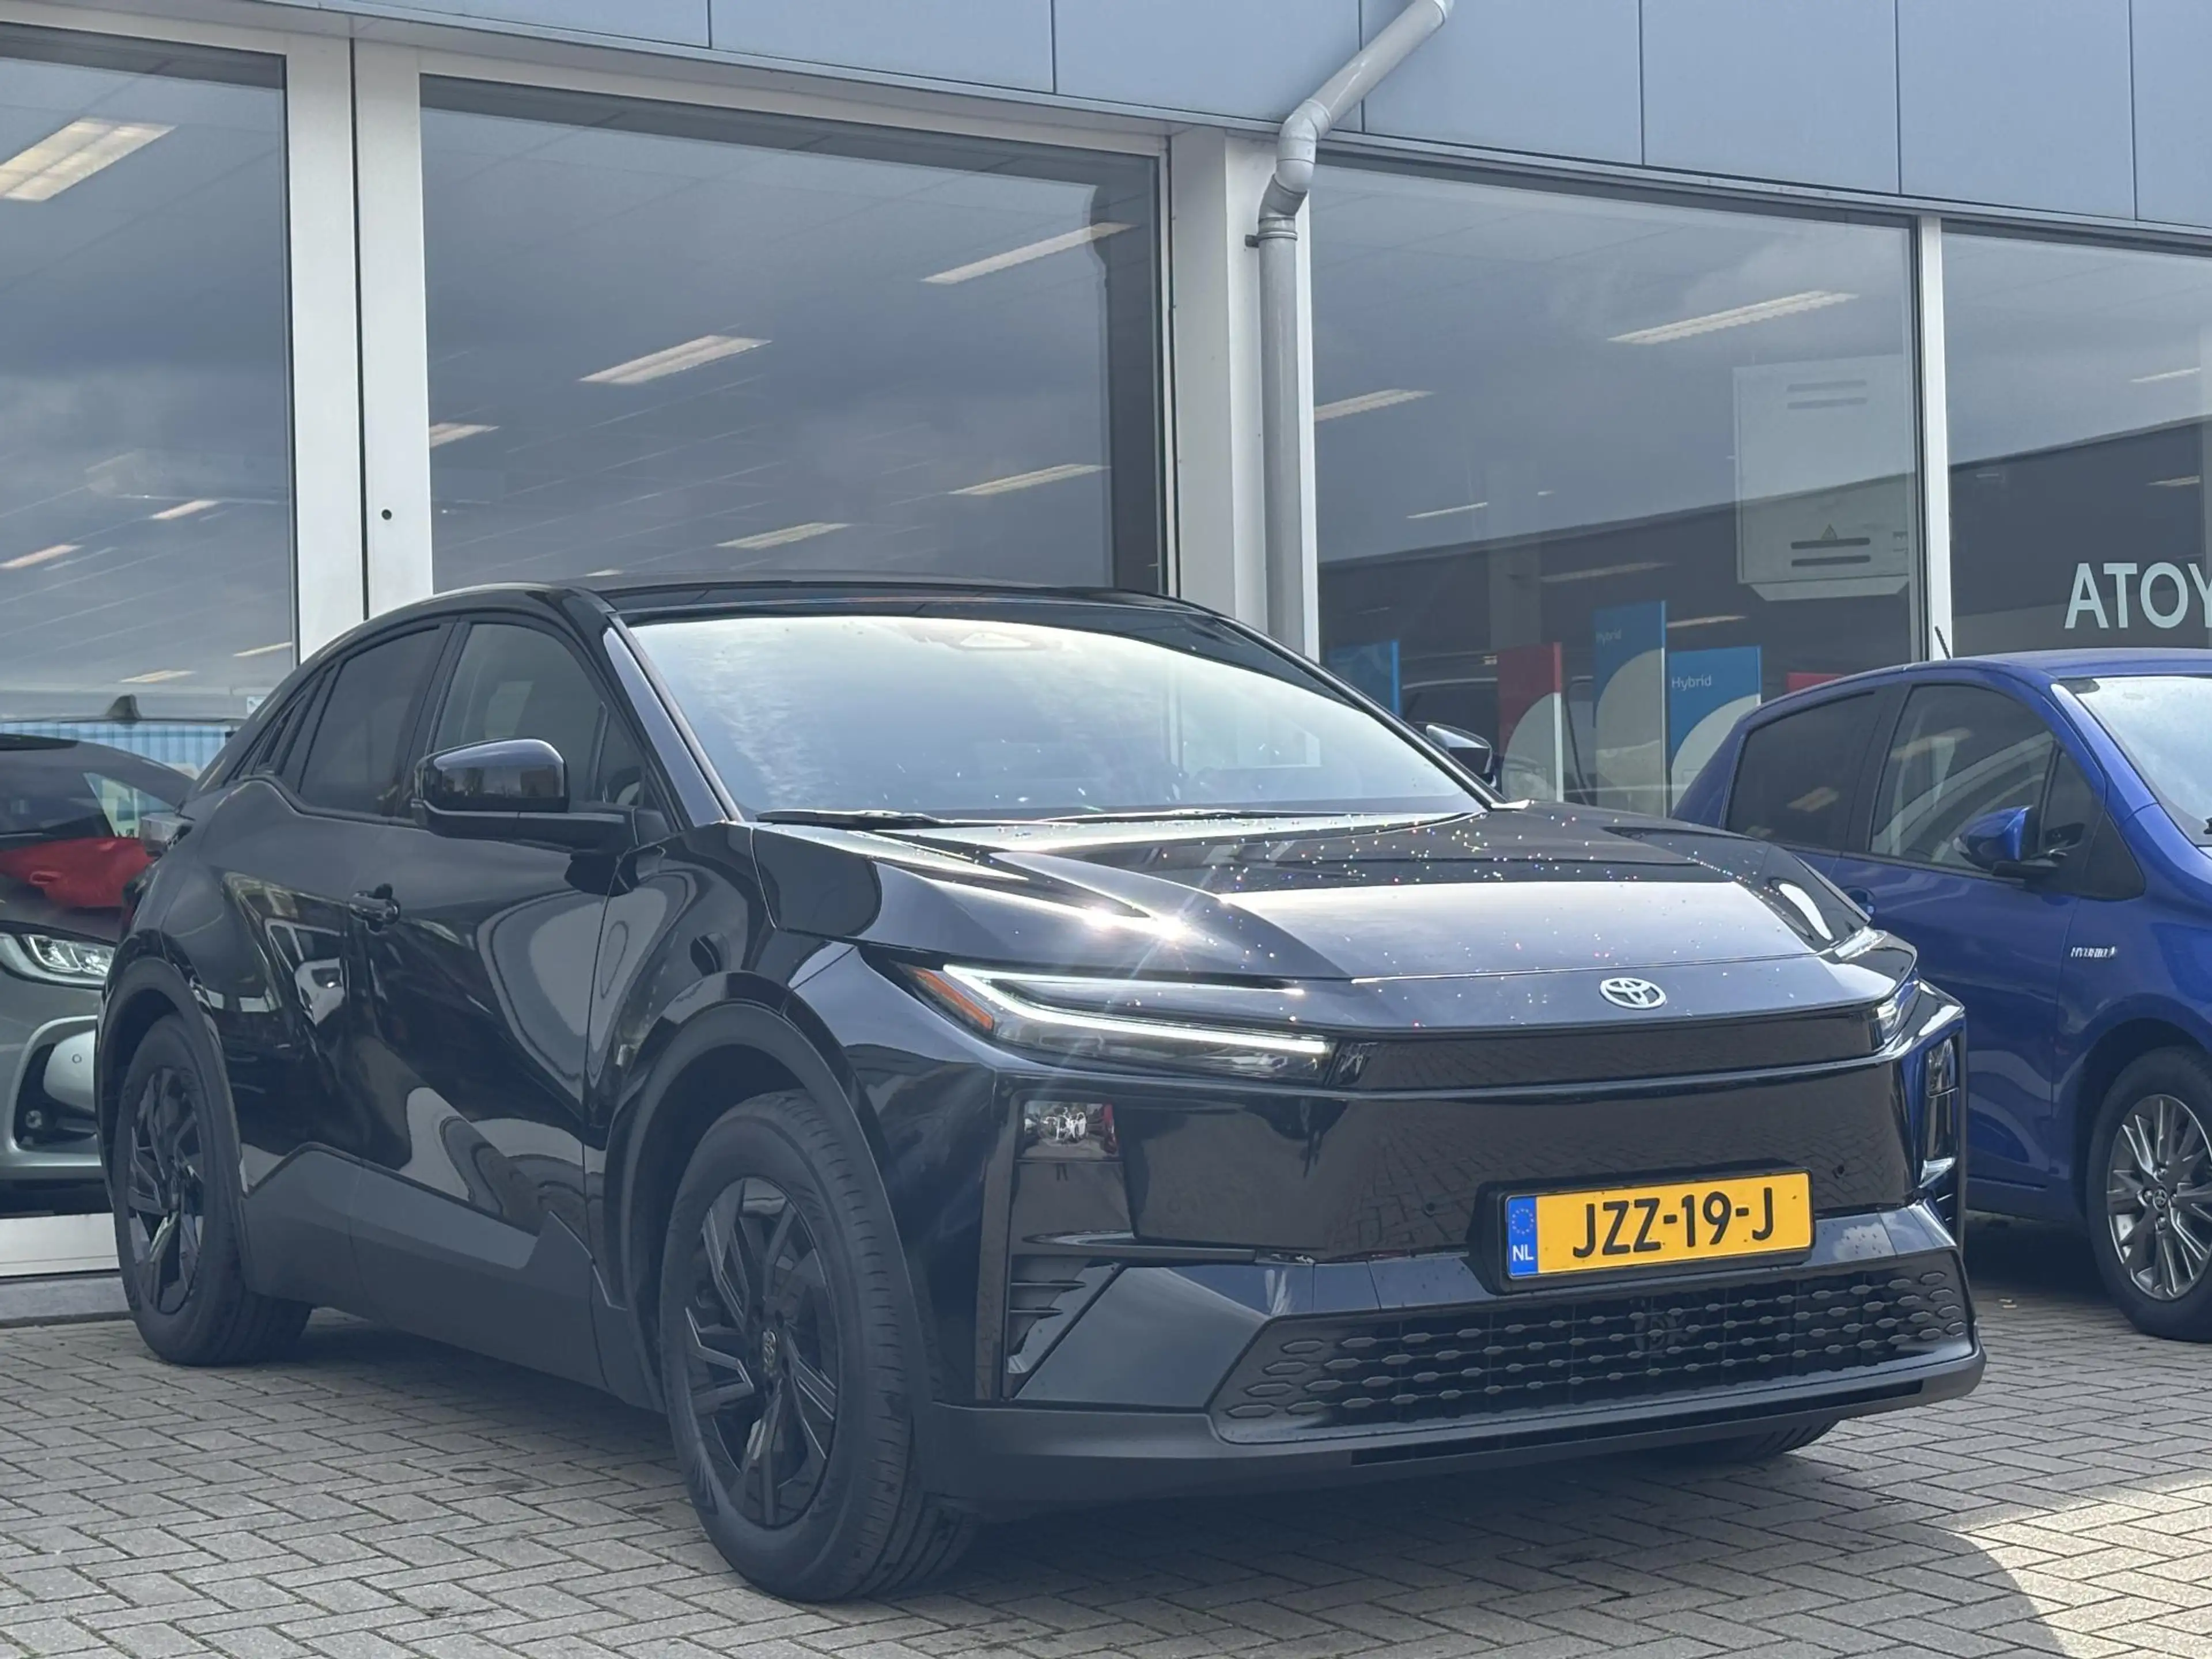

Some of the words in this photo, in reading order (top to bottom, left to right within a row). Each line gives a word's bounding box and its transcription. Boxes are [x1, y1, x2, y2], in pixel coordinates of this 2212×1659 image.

[1672, 675, 1712, 691] Hybrid
[1573, 1187, 1774, 1259] JZZ-19-J
[1513, 1244, 1533, 1262] NL
